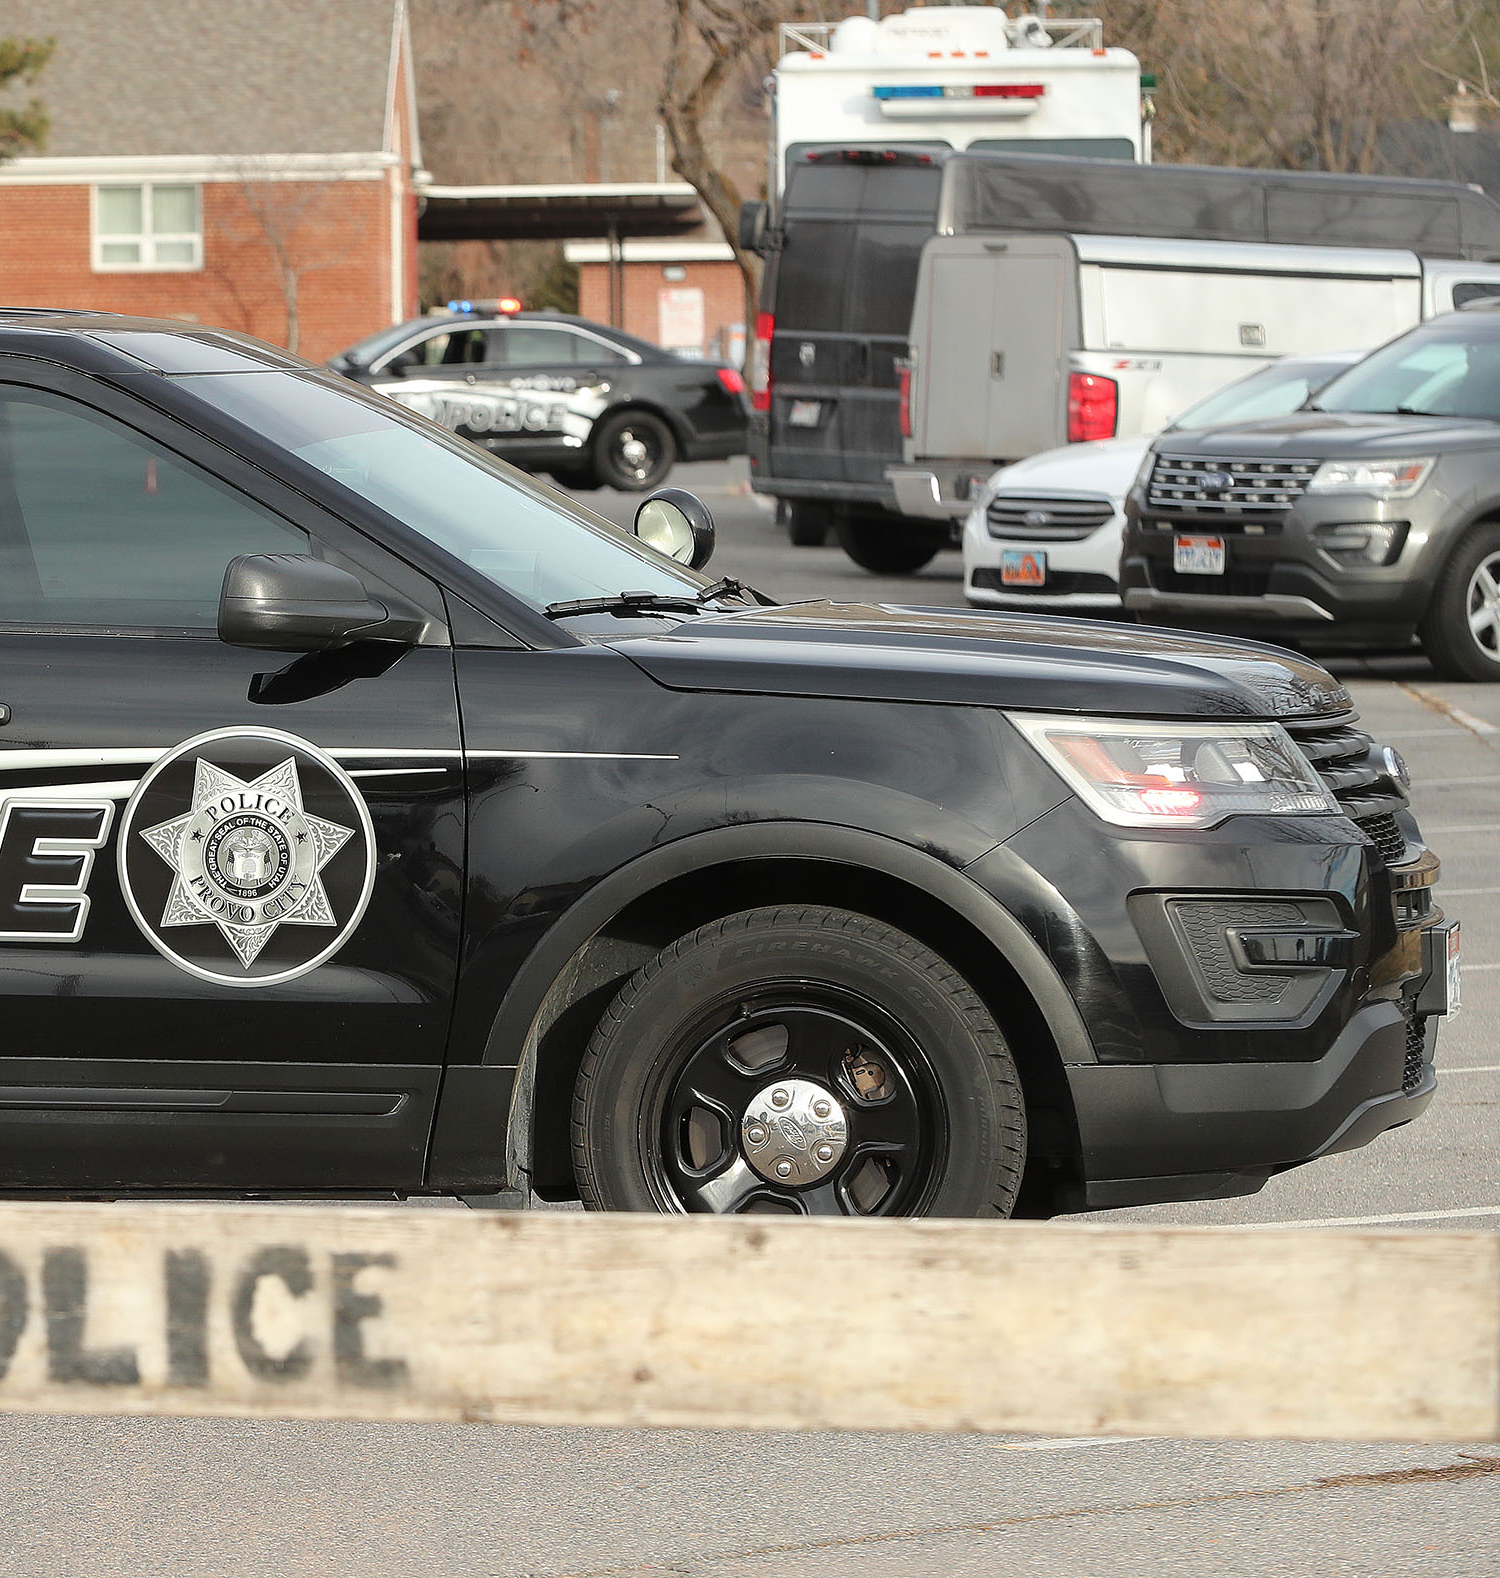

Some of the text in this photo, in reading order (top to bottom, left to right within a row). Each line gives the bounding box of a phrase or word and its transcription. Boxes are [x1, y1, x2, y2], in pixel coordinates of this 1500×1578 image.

[444, 400, 568, 433] POLICE
[204, 793, 295, 826] POLICE
[236, 817, 249, 826] OF
[215, 821, 236, 840] SEAL
[250, 817, 268, 830] THE
[267, 825, 287, 852] STATE
[208, 840, 219, 869] GREAT
[280, 852, 289, 866] OF
[211, 869, 228, 889] THE
[268, 865, 287, 889] UTAH
[190, 873, 307, 922] PROVO CITY
[238, 889, 258, 898] 1896
[734, 941, 900, 979] FIREHAWK
